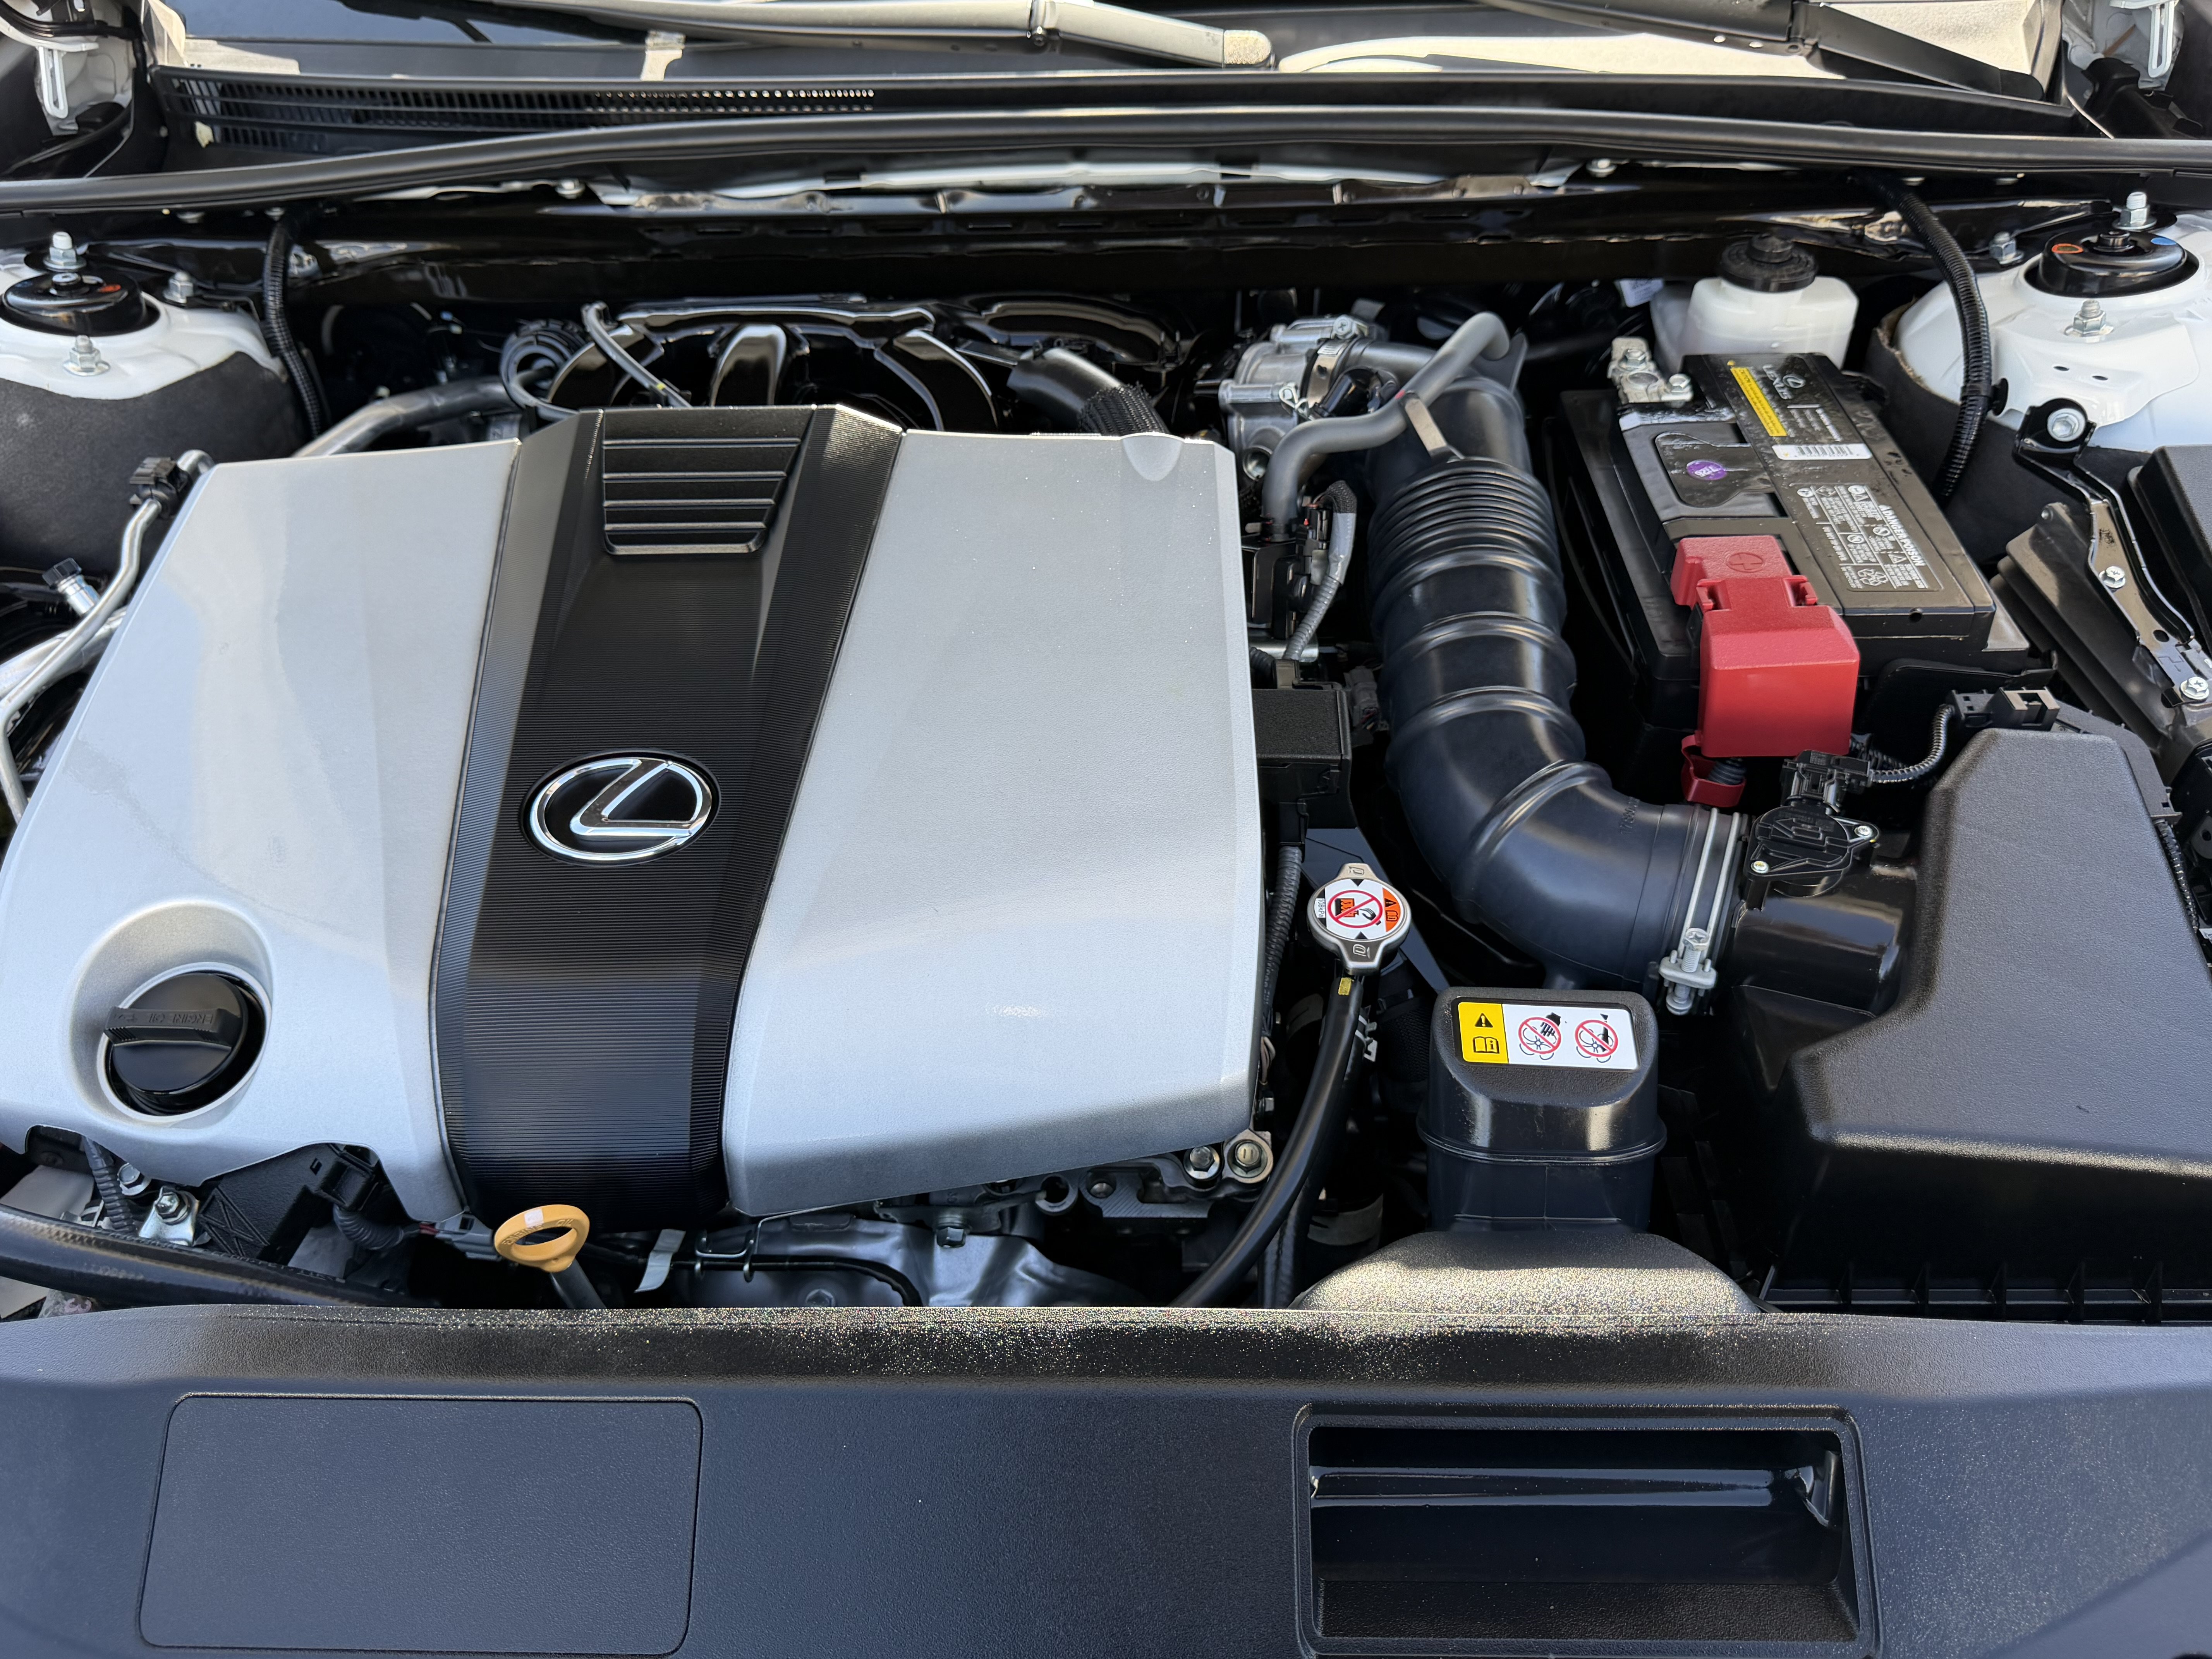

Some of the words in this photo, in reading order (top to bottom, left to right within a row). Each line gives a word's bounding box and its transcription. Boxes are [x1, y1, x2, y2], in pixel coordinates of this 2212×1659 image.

[1763, 364, 1794, 400] LEXUS
[1882, 510, 1926, 566] DANGER/POISON
[501, 1223, 544, 1246] ENGINE
